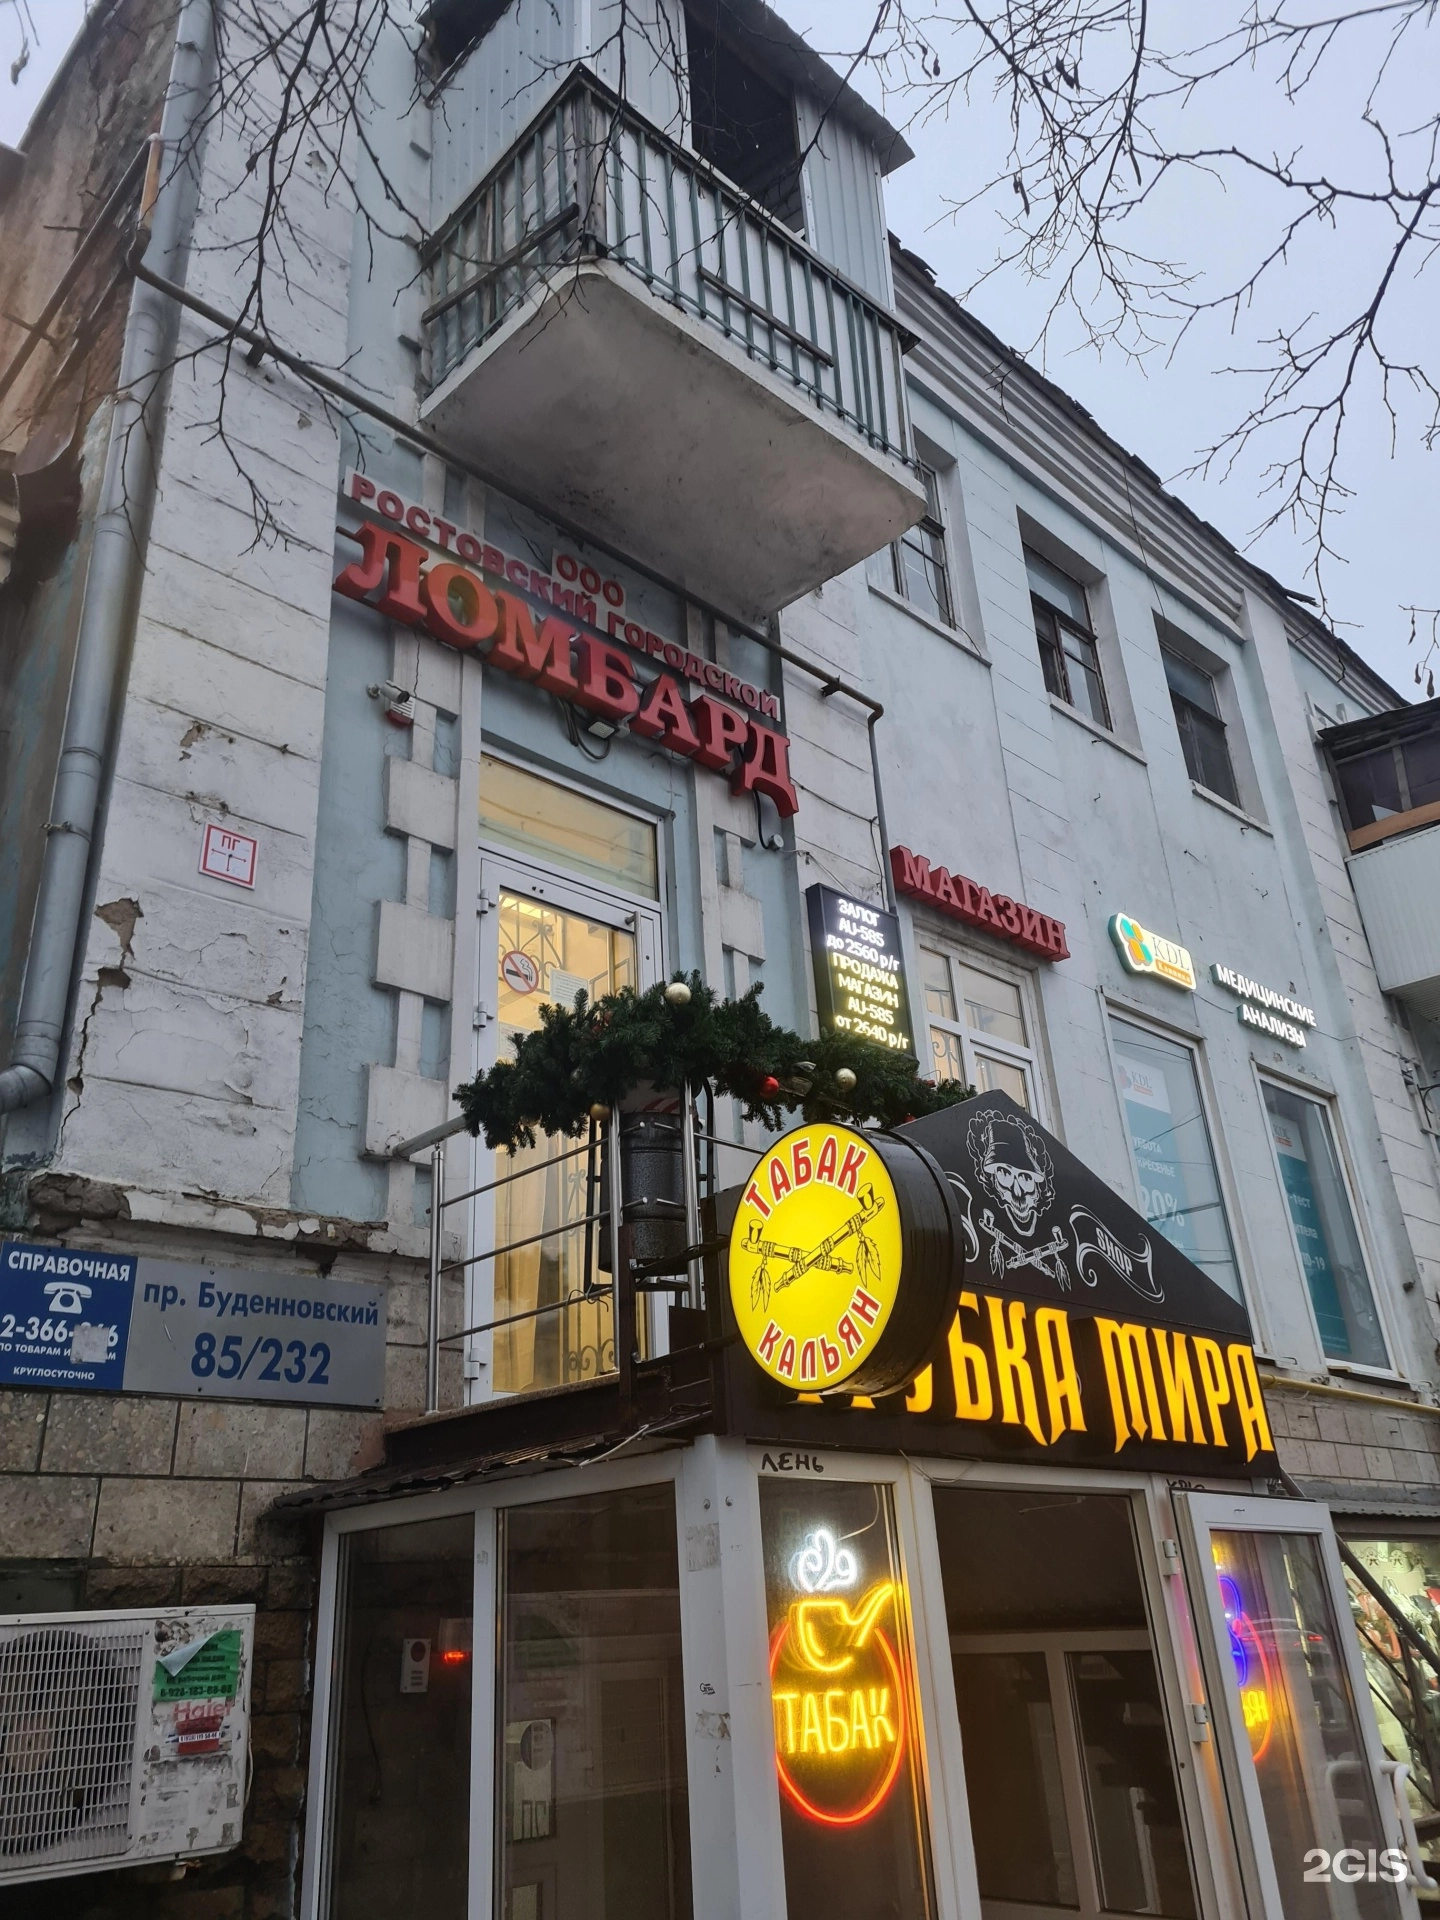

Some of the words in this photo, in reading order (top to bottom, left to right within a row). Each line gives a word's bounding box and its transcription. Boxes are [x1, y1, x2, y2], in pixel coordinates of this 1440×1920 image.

[351, 474, 597, 625] РОСТОВСКИЙ
[607, 611, 779, 720] ГОРОДСКОЙ
[556, 553, 625, 607] ООО
[334, 520, 799, 818] ЛОМБАРД
[222, 835, 240, 851] ПГ
[838, 898, 880, 927] ЗАЛОГ
[890, 845, 1071, 962] МАГАЗИН
[839, 917, 885, 947] AU-585
[826, 934, 845, 950] до
[845, 938, 879, 963] 2560
[880, 954, 900, 971] р/г
[832, 952, 899, 989] ПРОДАЖА
[1151, 936, 1190, 971] KDL
[838, 973, 899, 1008] МАГАЗИН
[1215, 963, 1318, 1027] МЕДИЦИНСКИЕ
[835, 1015, 852, 1029] от
[848, 996, 895, 1025] AU-585
[1242, 1003, 1307, 1048] АНАЛИЗЫ
[1131, 1071, 1153, 1089] KDL
[743, 1134, 869, 1221] ТАБАК
[8, 1250, 130, 1281] СПРАВОЧНАЯ
[1096, 1227, 1133, 1277] SHOP
[144, 1283, 186, 1311] пр.
[198, 1281, 379, 1326] Буденновский
[0, 1313, 119, 1347] 2-366-6
[756, 1284, 883, 1383] КАЛЬЯН
[15, 1344, 61, 1356] ТОВАРАМ
[190, 1332, 331, 1385] 85/232
[13, 1366, 96, 1380] КРУГЛОСУТОЧНО
[1092, 1316, 1275, 1464] МИРА
[761, 1452, 824, 1473] ЛЕНЬ
[173, 1699, 232, 1721] Haier
[773, 1687, 895, 1754] ТАБАК
